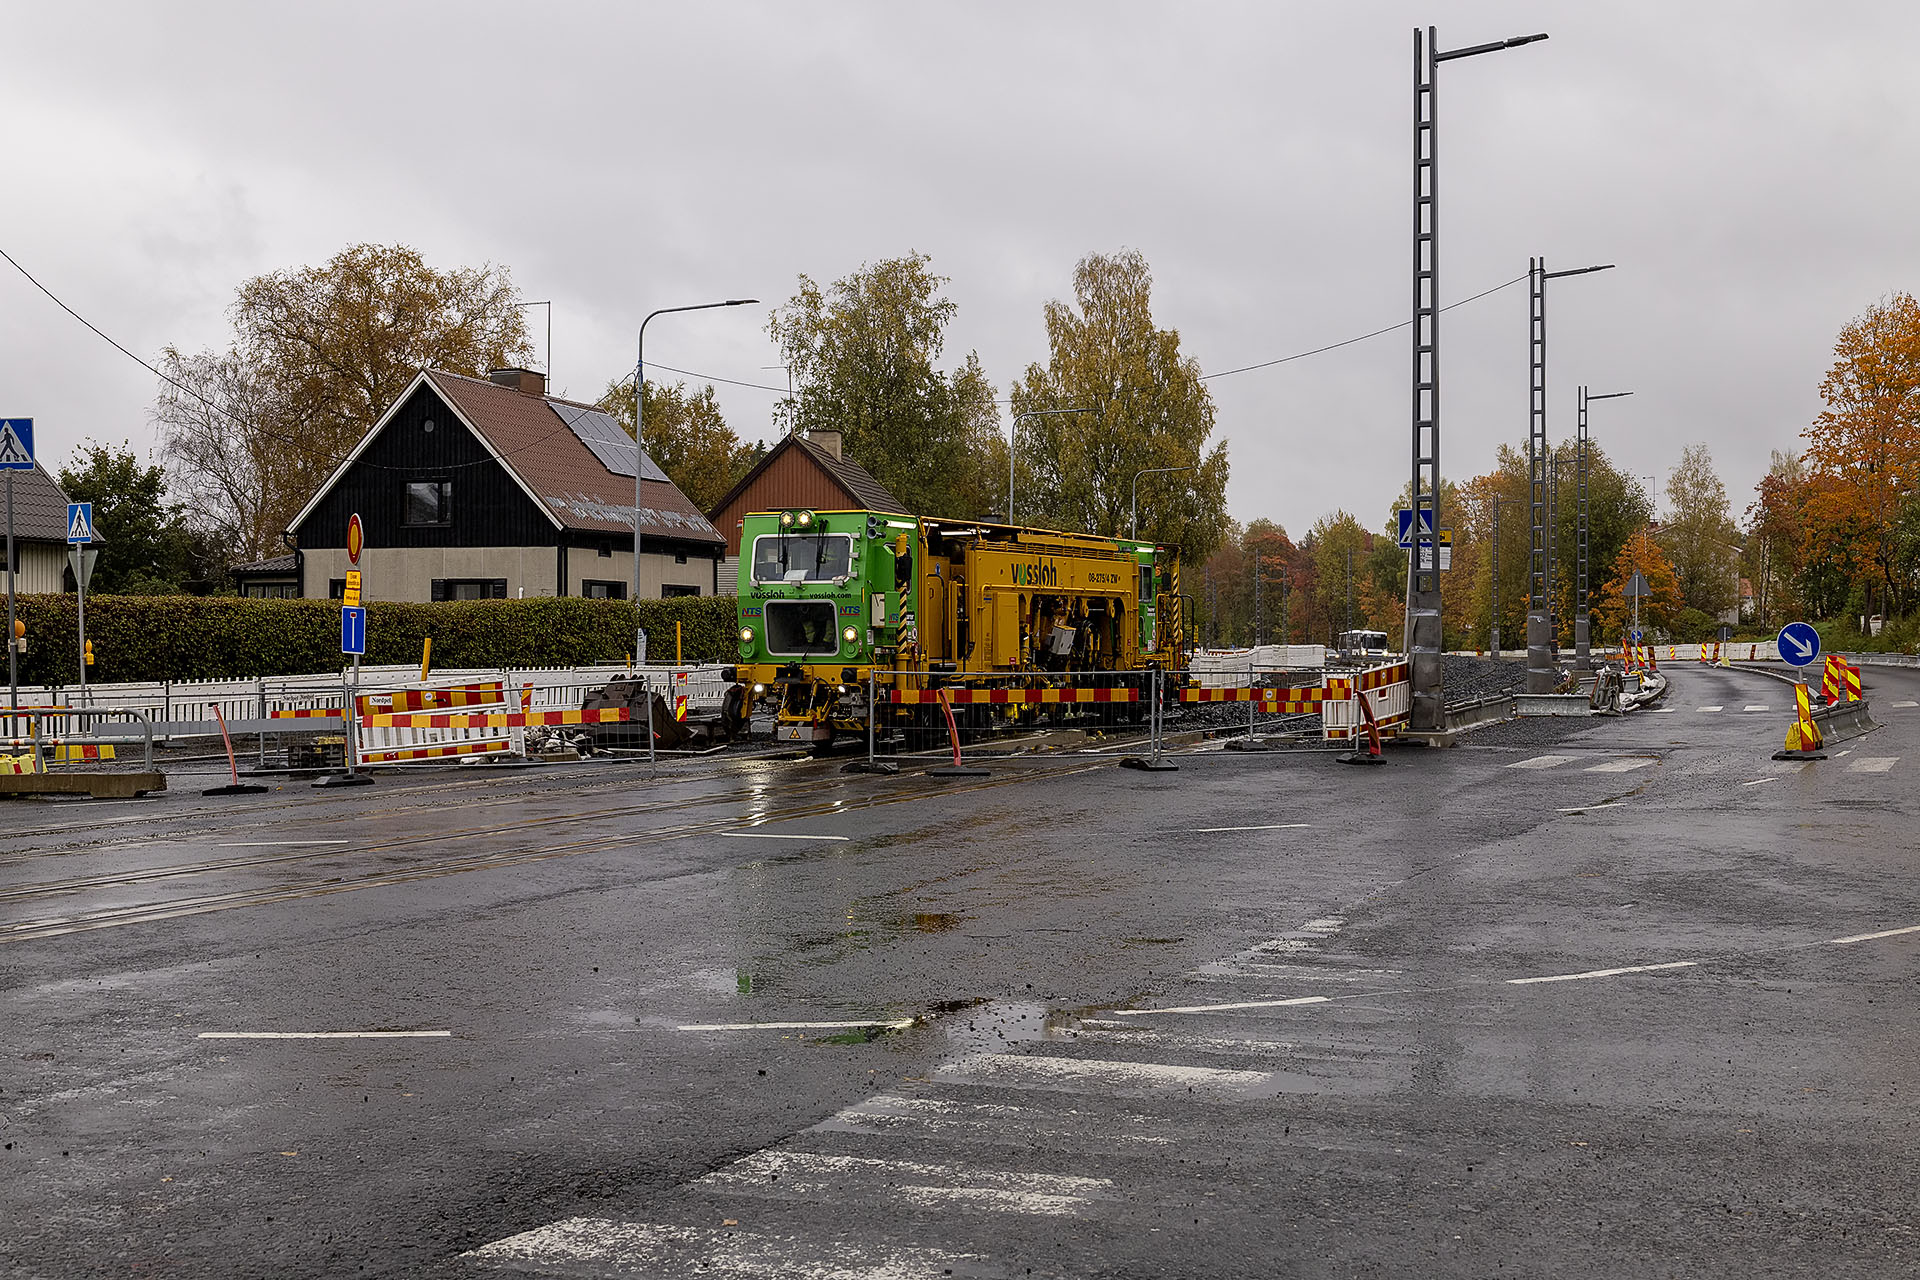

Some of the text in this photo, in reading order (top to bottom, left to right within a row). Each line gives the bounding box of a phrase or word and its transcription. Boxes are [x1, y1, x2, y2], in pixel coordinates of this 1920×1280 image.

[1011, 557, 1057, 586] vossloh
[750, 590, 785, 599] vossloh
[742, 607, 762, 616] NTS
[840, 606, 861, 615] NTS
